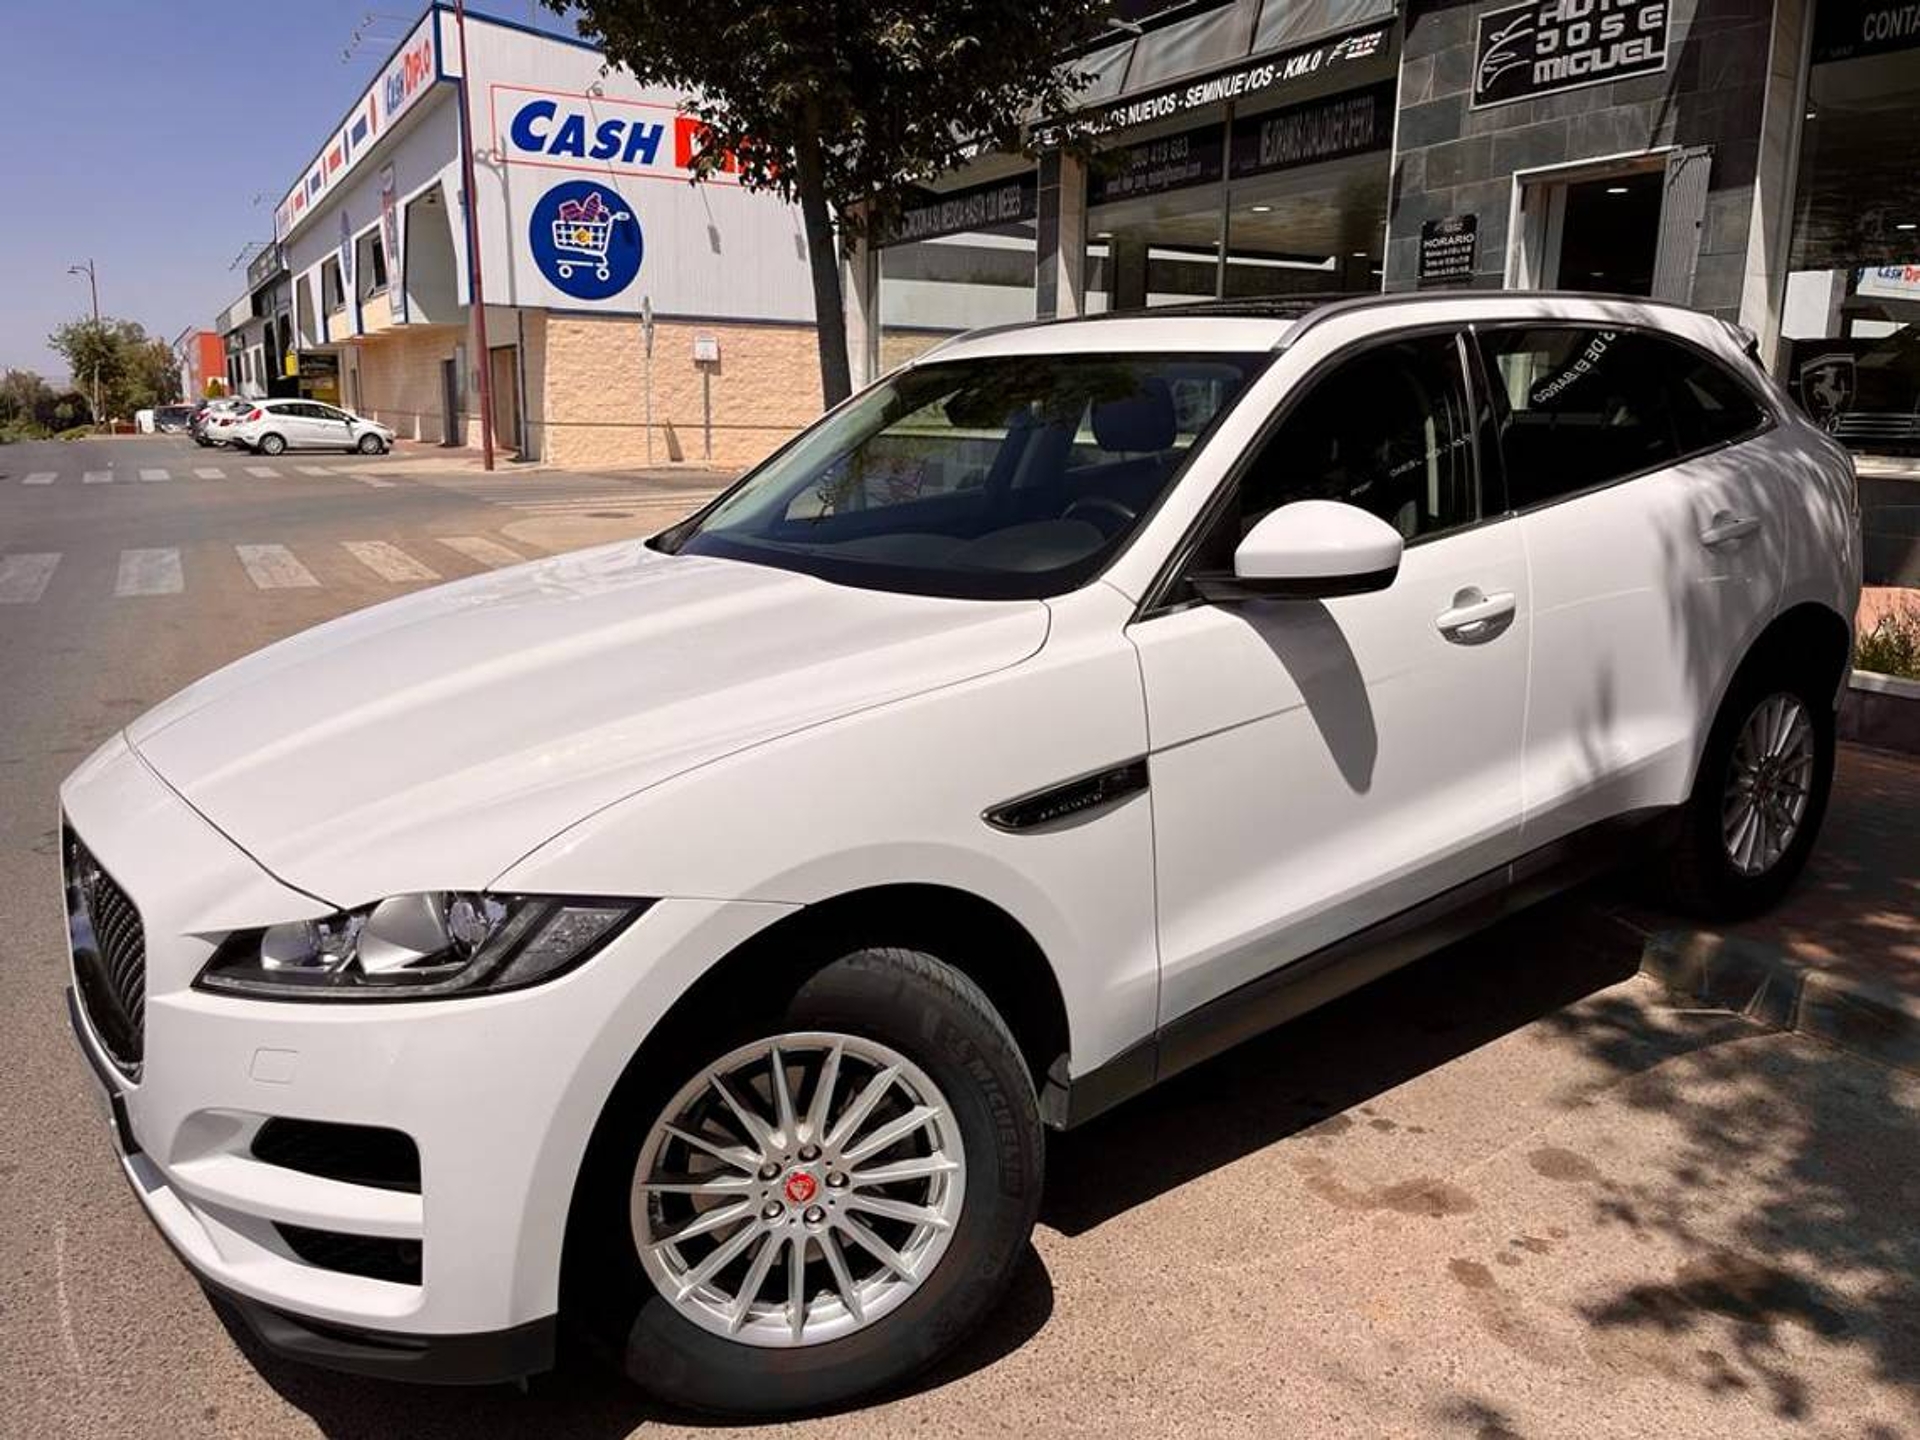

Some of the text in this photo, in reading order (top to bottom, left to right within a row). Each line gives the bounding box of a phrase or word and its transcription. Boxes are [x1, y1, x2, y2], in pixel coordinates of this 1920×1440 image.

[1535, 4, 1665, 54] JOSE
[1533, 36, 1666, 84] MIGUEL
[1128, 93, 1177, 126] NUEVOS
[1185, 68, 1273, 110] SEMINUEVOS
[1284, 50, 1322, 78] KM.0
[510, 100, 664, 165] CASH
[1423, 233, 1474, 249] HORARIO
